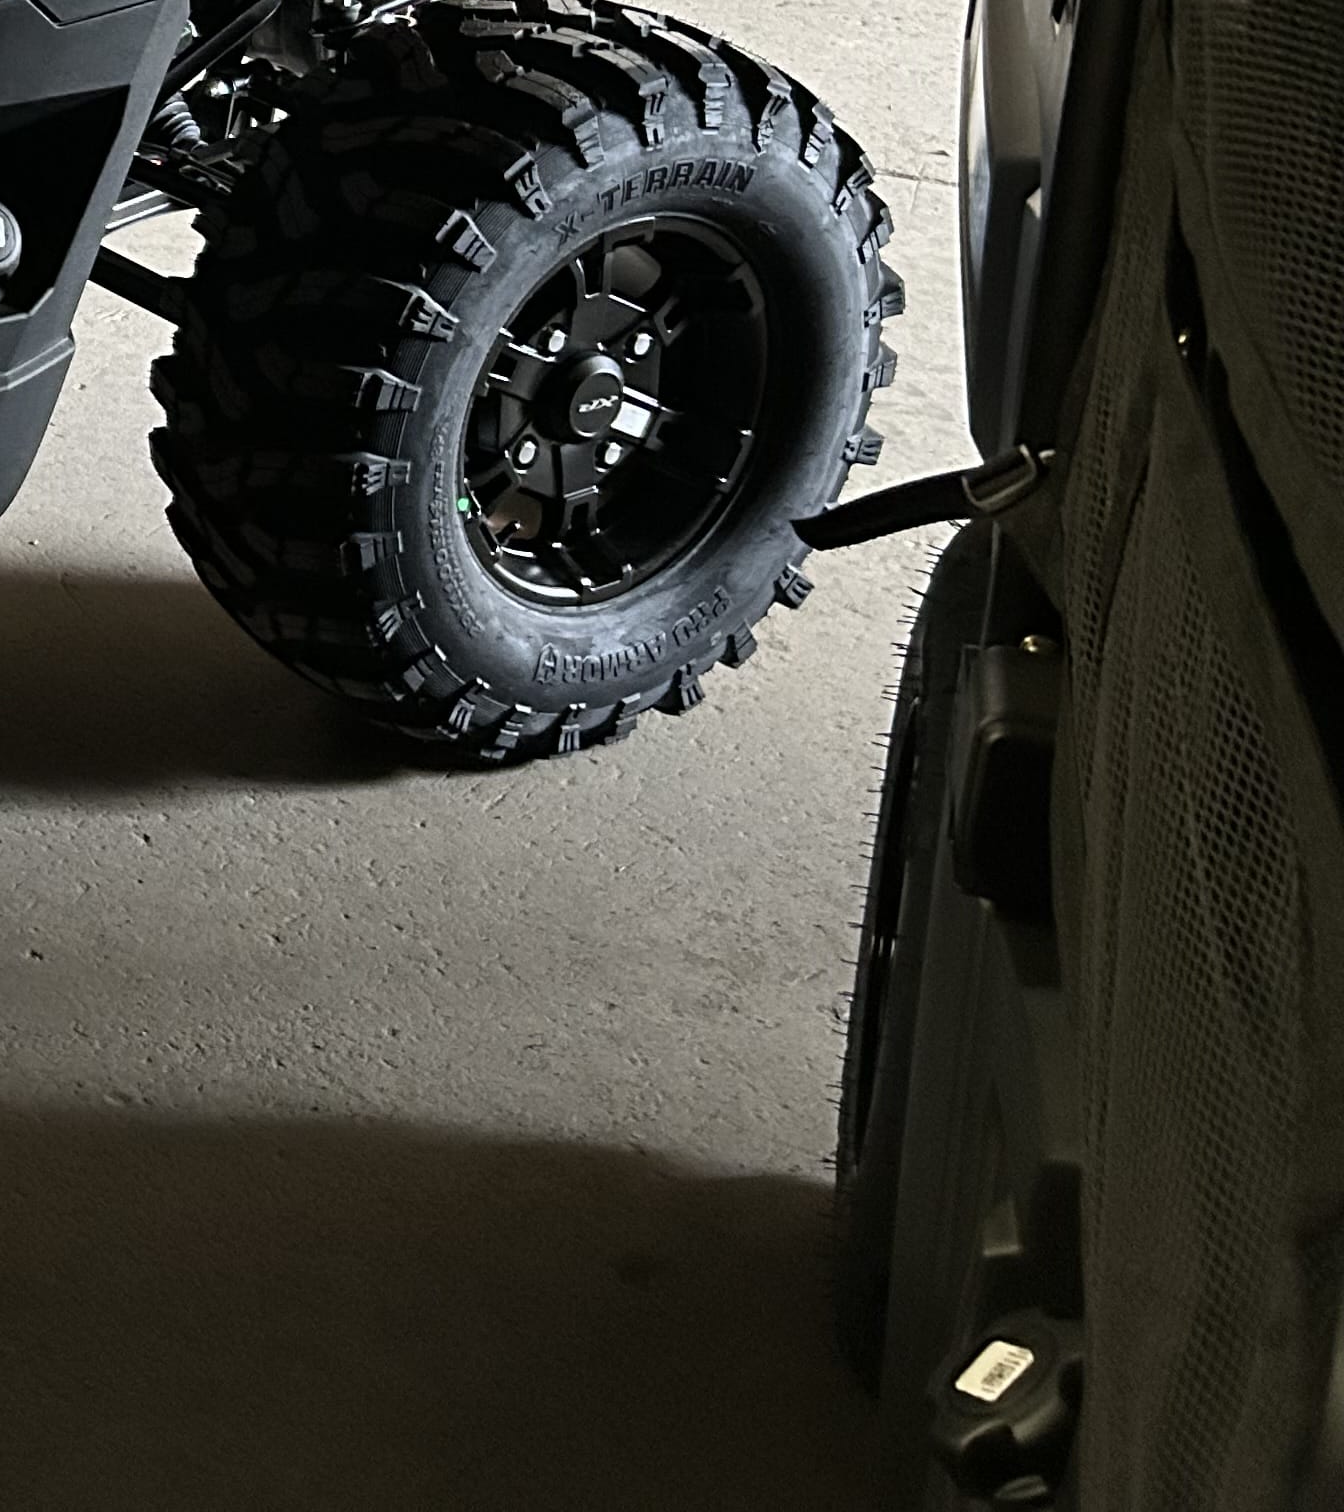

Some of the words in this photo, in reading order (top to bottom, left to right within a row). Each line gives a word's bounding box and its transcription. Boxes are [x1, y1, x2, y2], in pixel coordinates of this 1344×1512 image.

[553, 158, 756, 248] X-TERRAIN
[672, 585, 732, 648] PRO
[563, 630, 667, 684] ARMOR
